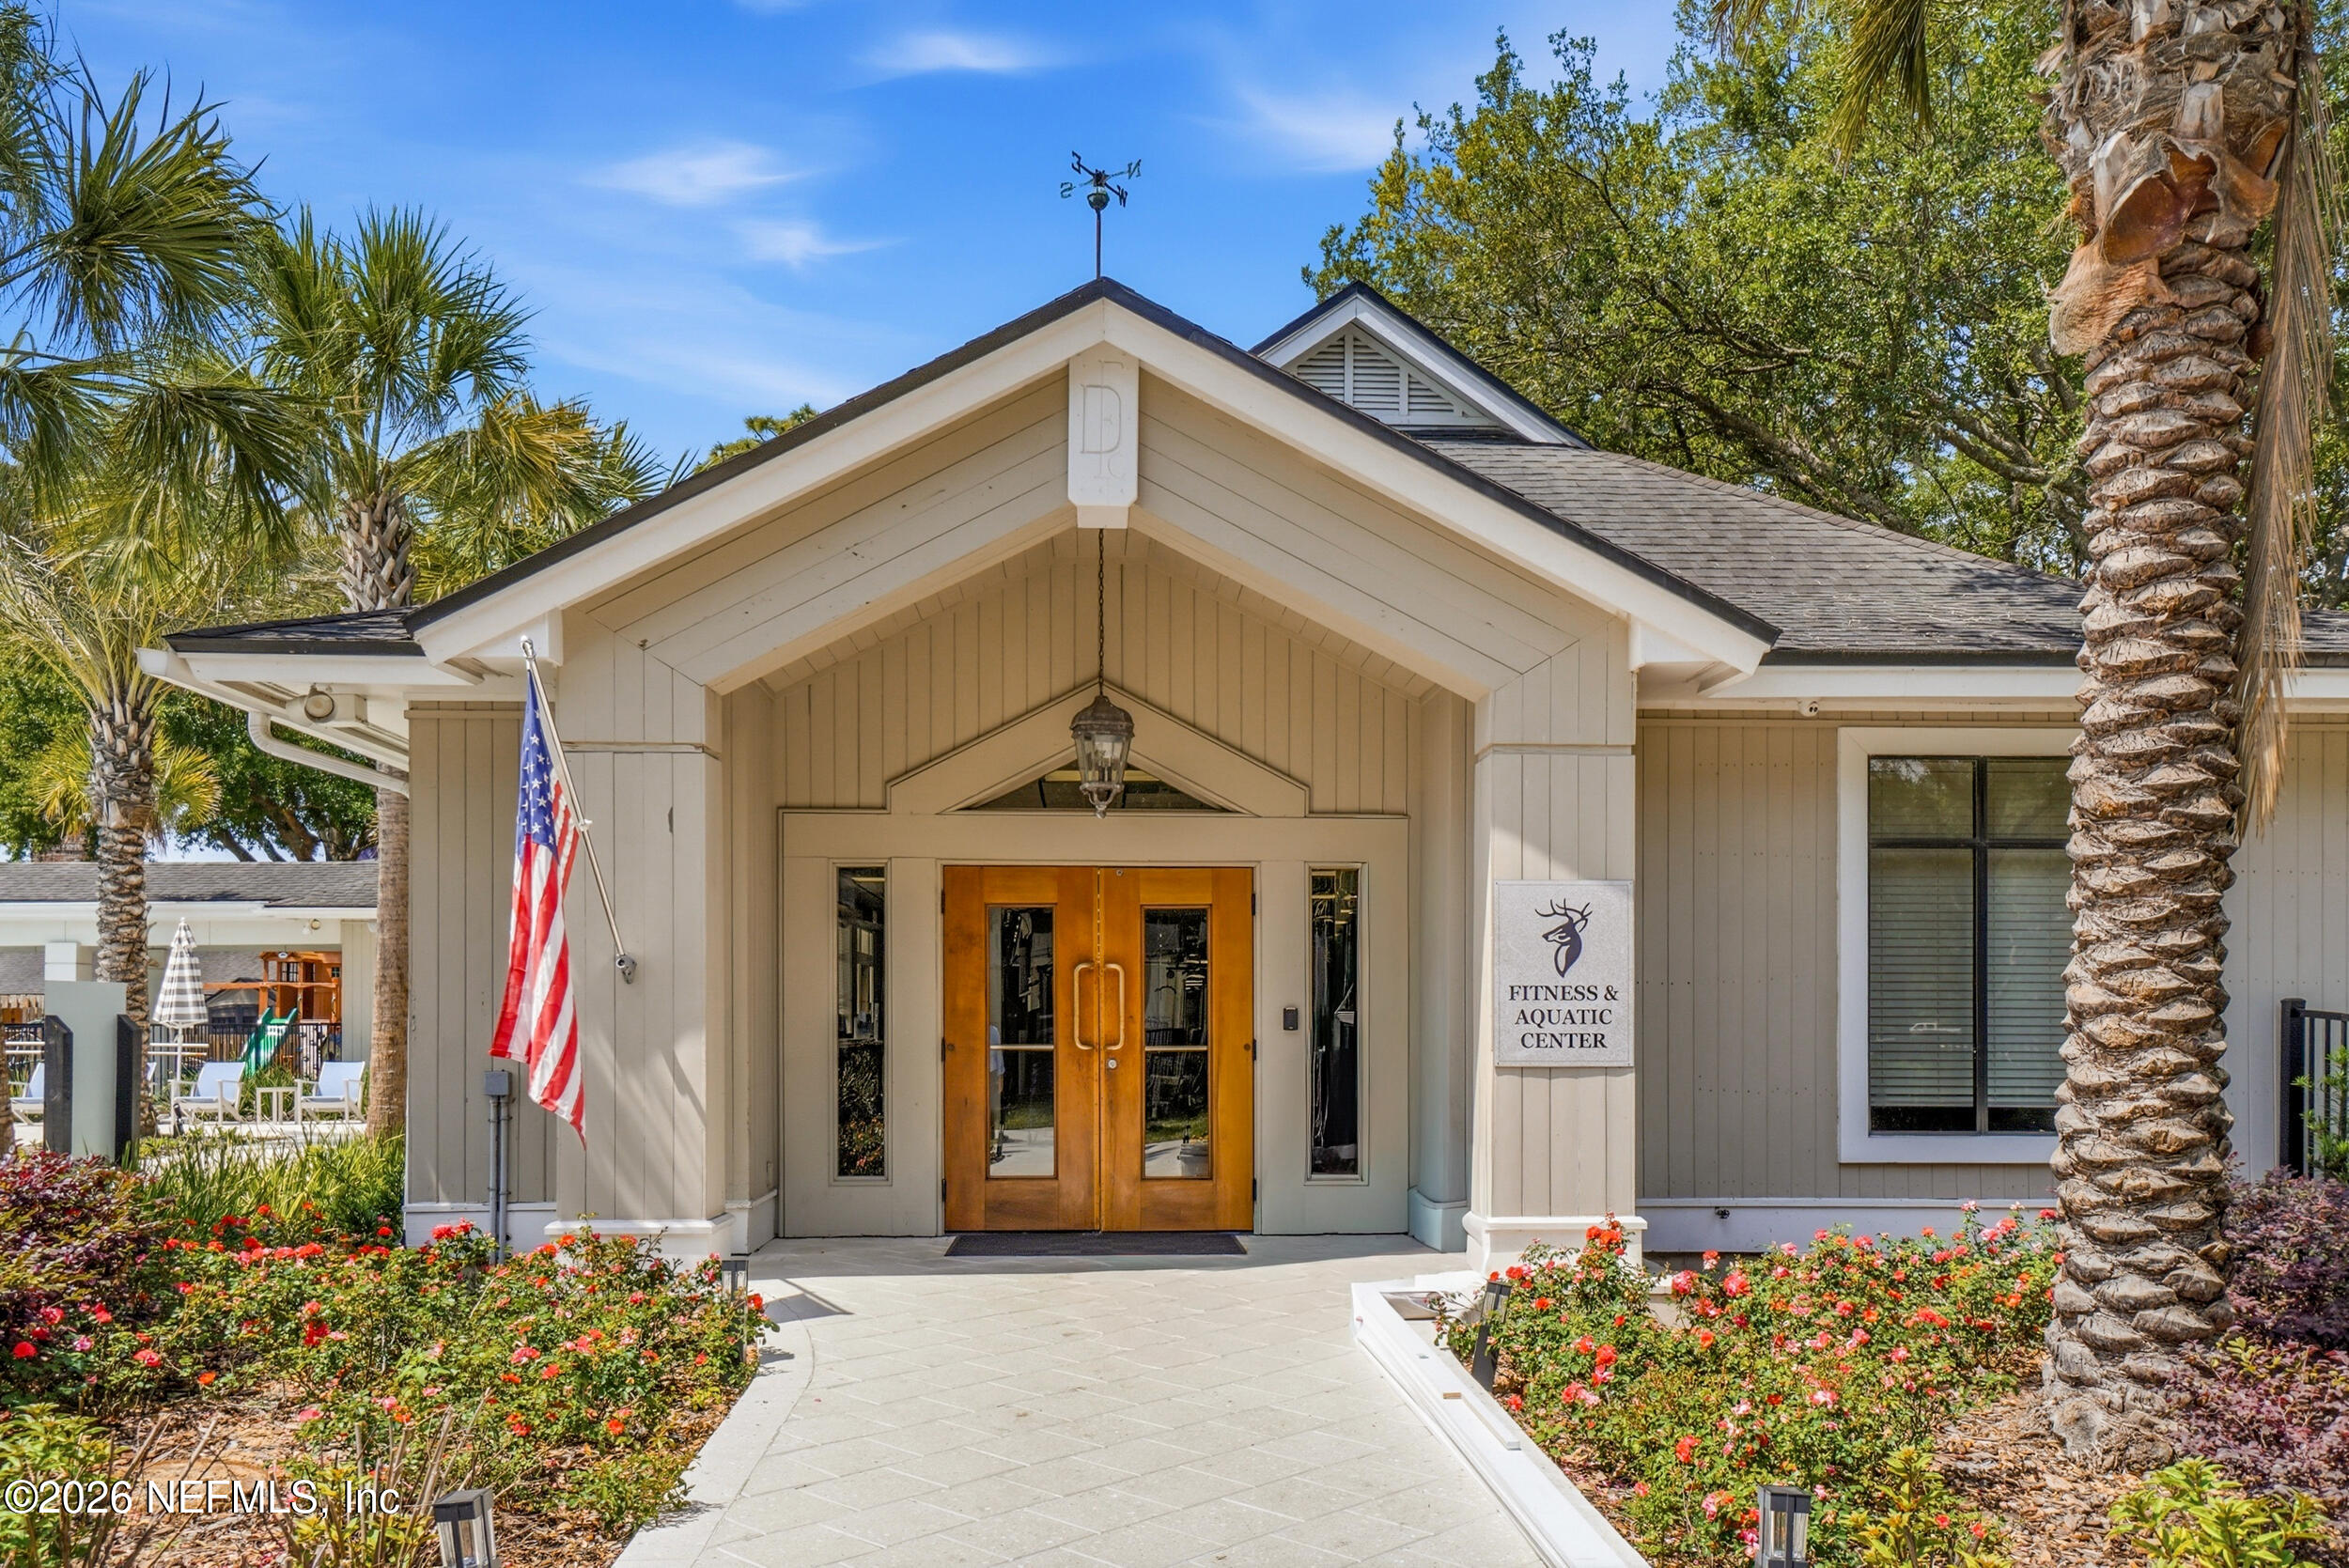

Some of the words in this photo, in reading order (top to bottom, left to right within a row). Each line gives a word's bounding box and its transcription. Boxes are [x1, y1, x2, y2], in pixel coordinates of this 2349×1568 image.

[1508, 985, 1598, 1001] FITNESS
[1604, 985, 1619, 1001] &
[1515, 1008, 1612, 1029] AQUATIC
[1520, 1032, 1608, 1048] CENTER
